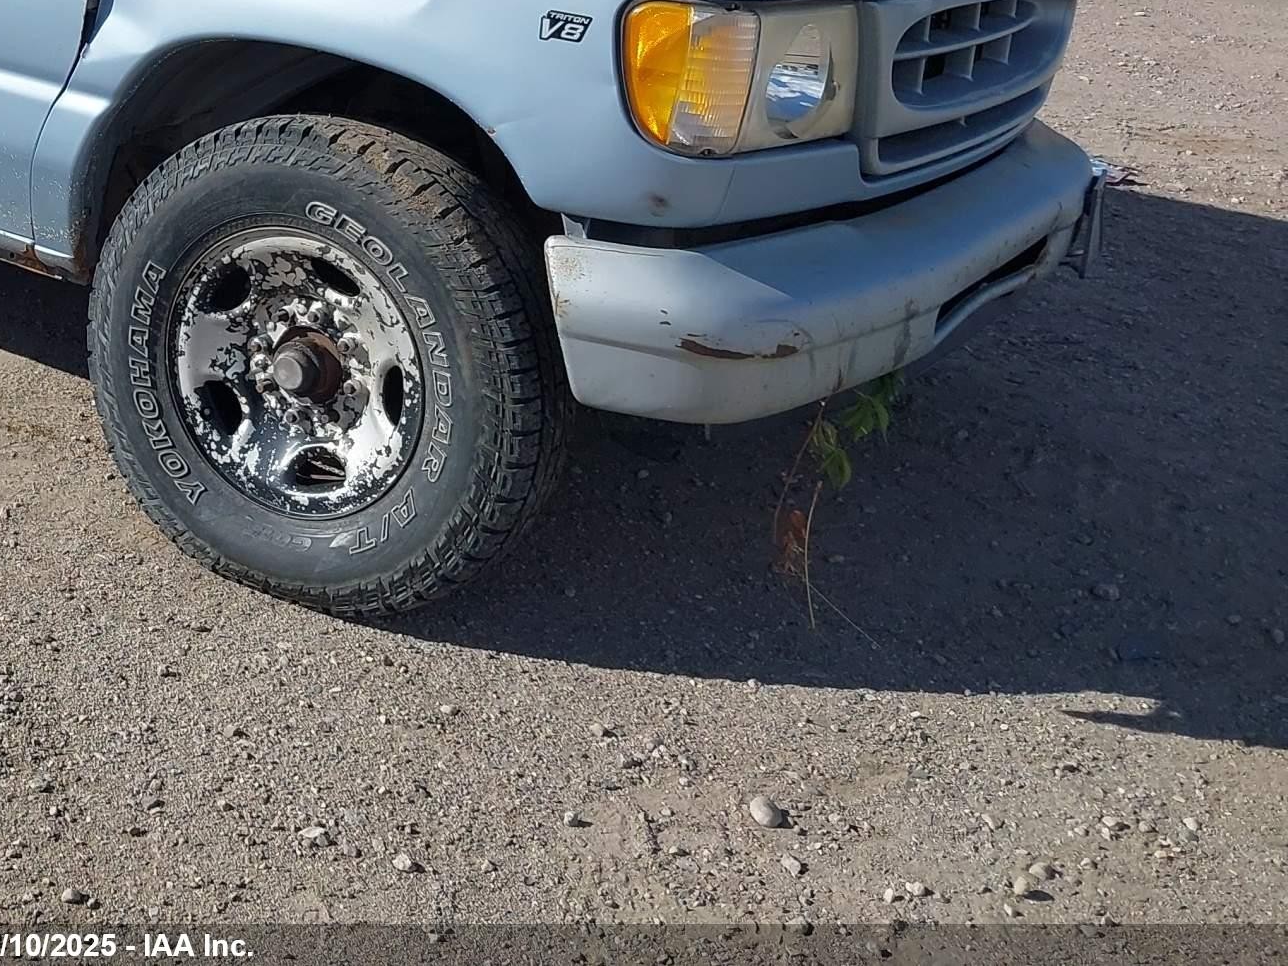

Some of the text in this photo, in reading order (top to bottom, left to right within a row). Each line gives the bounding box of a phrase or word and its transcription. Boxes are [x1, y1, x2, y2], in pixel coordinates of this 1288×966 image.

[541, 18, 585, 41] V8
[549, 11, 591, 25] TRITON
[127, 259, 209, 506] YOKOHAMA
[305, 201, 452, 556] GEOLANDAR A/T
